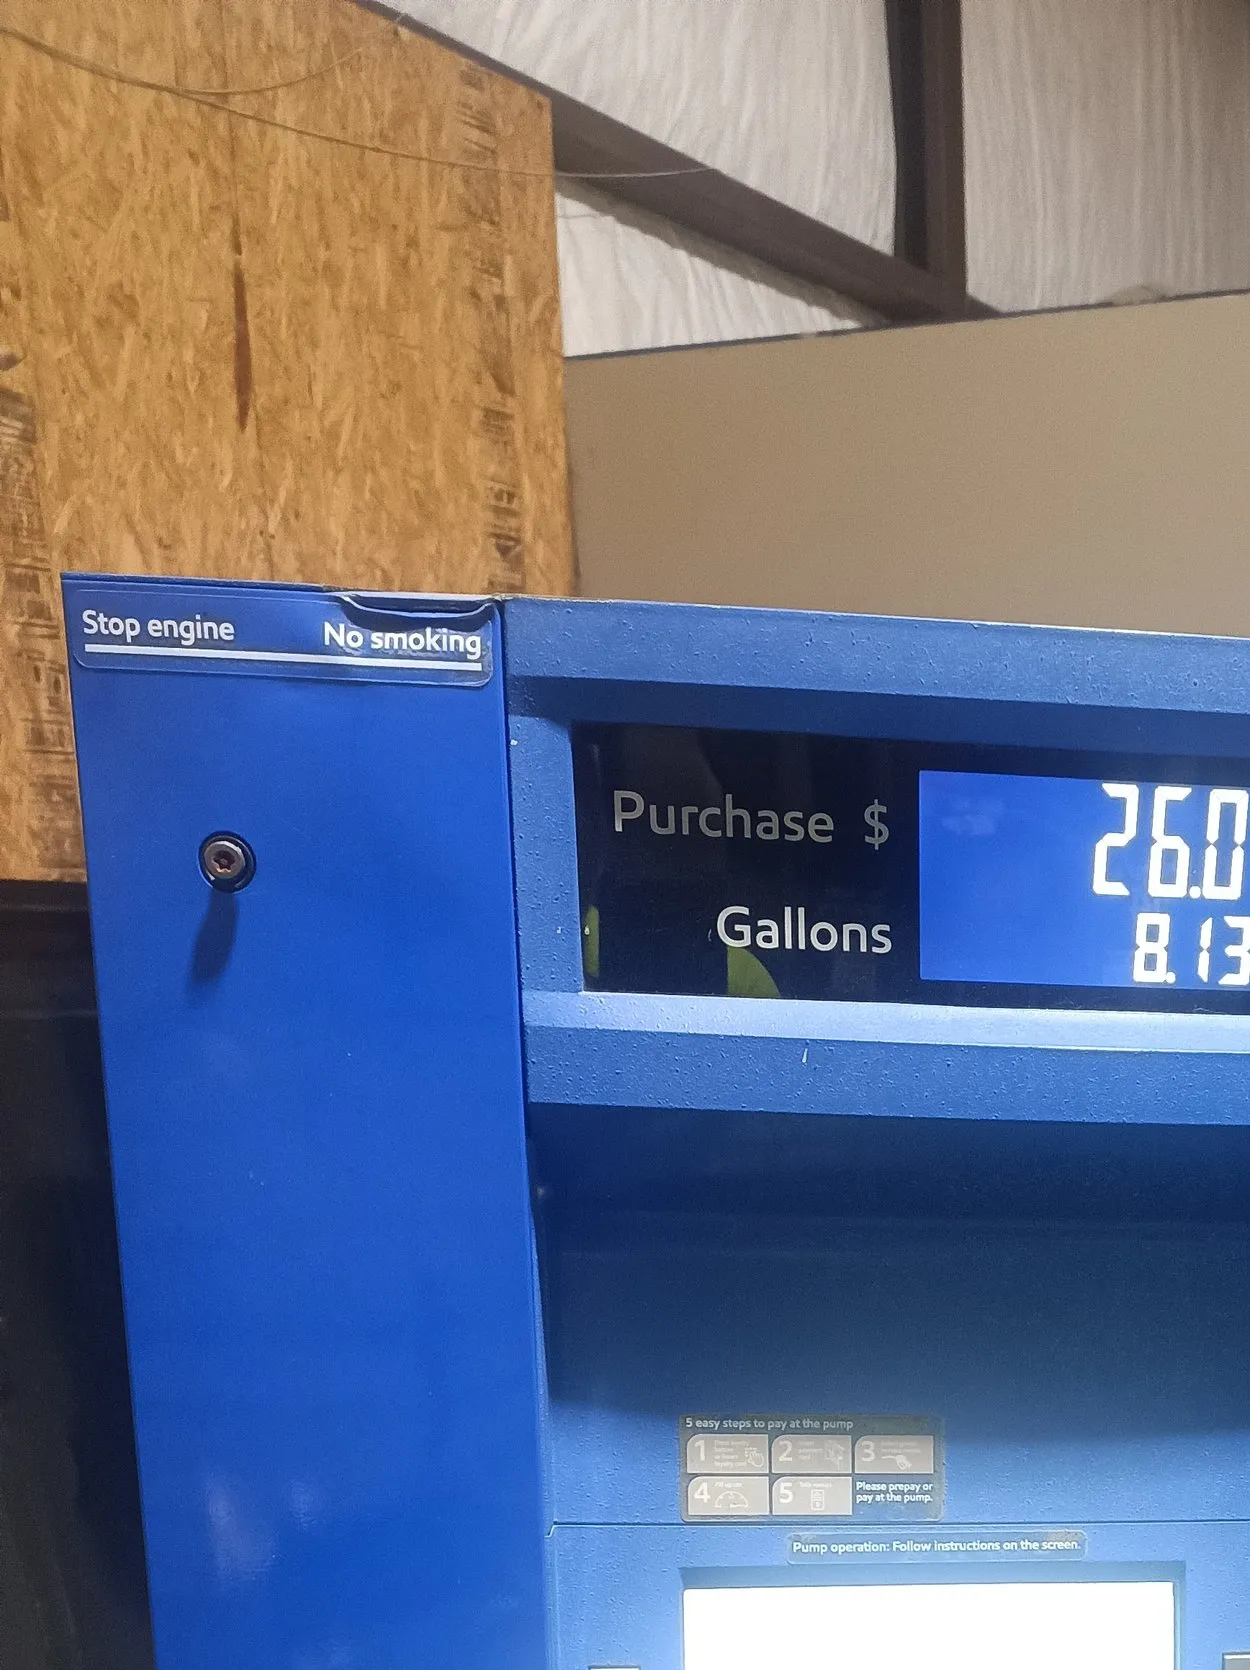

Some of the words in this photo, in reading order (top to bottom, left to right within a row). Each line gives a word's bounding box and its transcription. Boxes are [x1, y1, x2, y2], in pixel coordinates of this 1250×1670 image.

[82, 610, 140, 640] Stop
[148, 614, 235, 645] engine
[323, 622, 364, 649] No
[370, 624, 483, 659] smoking
[614, 790, 834, 843] Purchase
[863, 798, 890, 850] $
[716, 905, 892, 955] Gallons
[685, 1418, 693, 1428] 5
[695, 1419, 720, 1431] easy
[723, 1419, 751, 1431] steps
[752, 1419, 765, 1429] to
[767, 1420, 786, 1431] pay
[789, 1419, 800, 1429] at
[802, 1418, 820, 1429] the
[823, 1420, 854, 1431] pump
[694, 1440, 706, 1461] 1
[778, 1440, 793, 1461] 2
[861, 1440, 876, 1462] 3
[694, 1482, 711, 1503] 4
[779, 1482, 793, 1504] 5
[856, 1481, 887, 1491] Please
[889, 1482, 921, 1493] prepay
[923, 1483, 933, 1491] or
[856, 1494, 874, 1504] pay
[876, 1494, 886, 1502] at
[887, 1493, 902, 1502] the
[904, 1493, 933, 1504] pump.
[792, 1541, 828, 1555] Pump
[830, 1541, 890, 1555] operation:
[892, 1540, 931, 1552] Follow
[933, 1540, 1000, 1551] instructions
[1003, 1541, 1018, 1550] on
[1020, 1540, 1039, 1551] the
[1041, 1540, 1081, 1550] screen.
